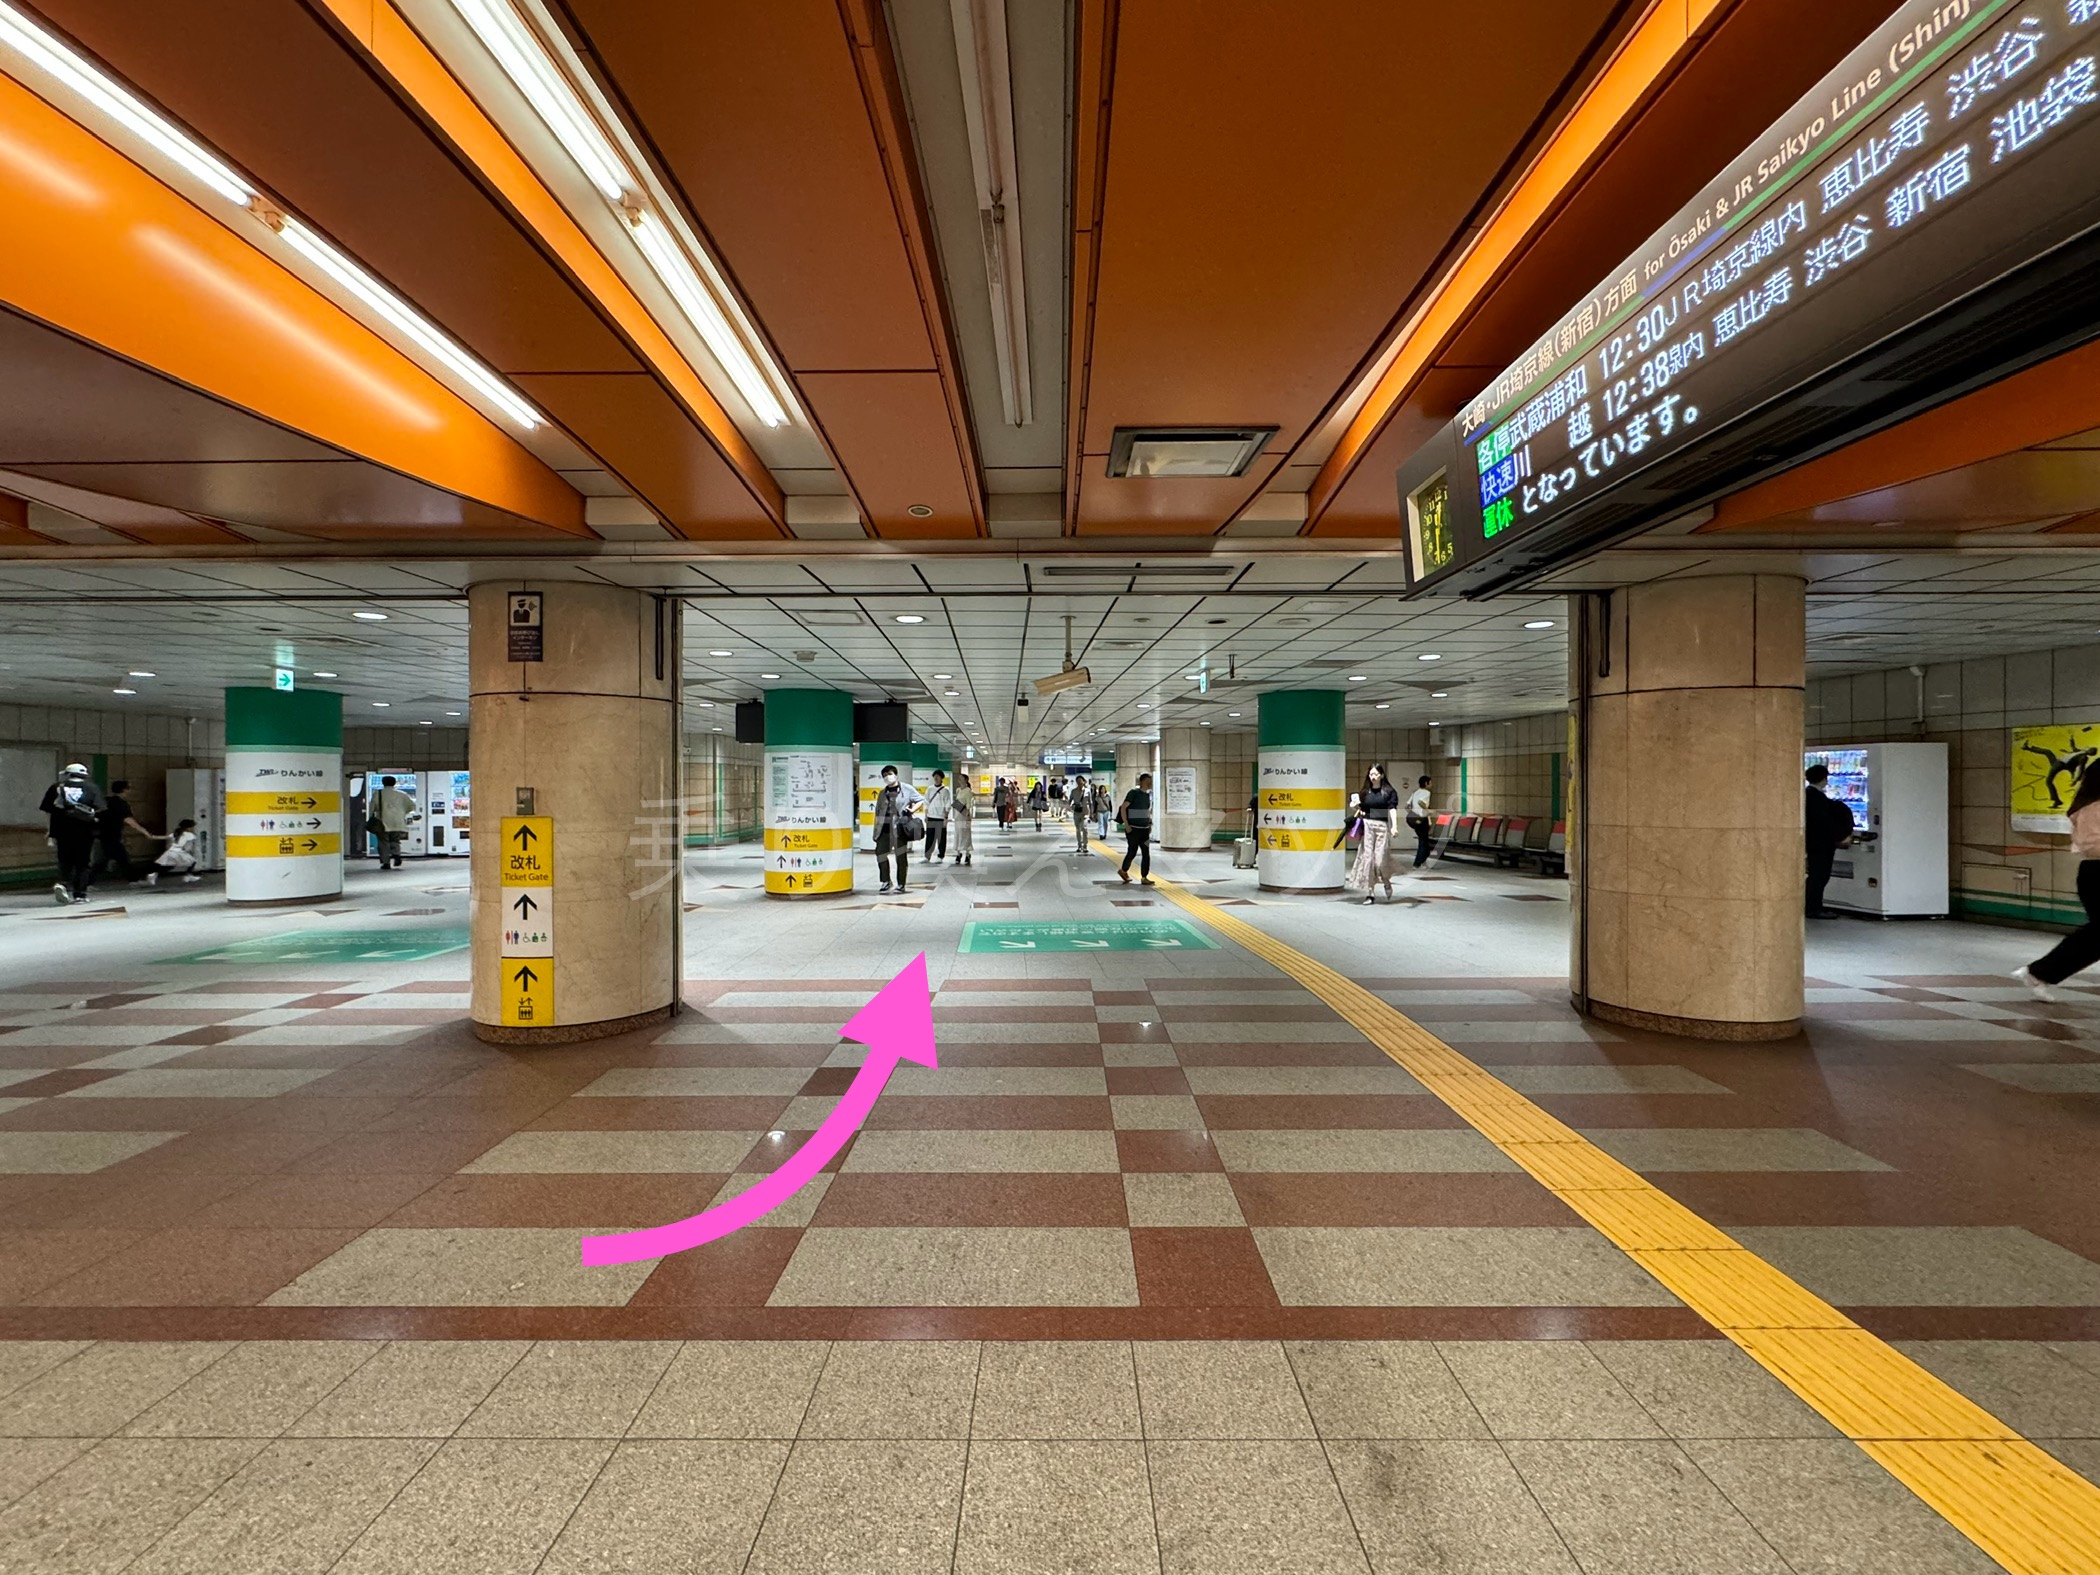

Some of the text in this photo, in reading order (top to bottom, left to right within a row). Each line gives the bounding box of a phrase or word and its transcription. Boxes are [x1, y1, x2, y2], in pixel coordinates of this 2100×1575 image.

[1478, 422, 1513, 472] 各停
[1509, 364, 1589, 450] 武蔵浦和
[1599, 305, 1666, 380] 12:30
[1818, 101, 1930, 215] 恵比寿
[1946, 17, 2046, 120] 渋谷
[1462, 268, 1638, 438] 大崎・JR埼京線(新宿)方面
[1644, 255, 1665, 280] for
[1668, 210, 1711, 259] Ōsaki
[1715, 198, 1730, 219] &
[1733, 175, 1754, 206] JR
[1757, 117, 1825, 184] Saikyo
[1831, 67, 1882, 123] Line
[1480, 457, 1516, 505] 快速
[1513, 445, 1533, 486] 川
[1566, 401, 1594, 450] 越
[1602, 350, 1670, 423] 12:38
[1712, 266, 1794, 348] 恵比寿
[1803, 214, 1874, 288] 渋谷
[1885, 142, 1971, 229] 新宿
[1989, 56, 2099, 165] 池袋
[1522, 393, 1699, 515] となっています。
[280, 769, 323, 777] りんかい線
[277, 796, 299, 805] 改札
[1278, 792, 1294, 801] 改札
[791, 816, 827, 824] りんかい線
[793, 834, 810, 843] 改札
[510, 855, 541, 871] 改札
[504, 873, 549, 881] Ticket Gate
